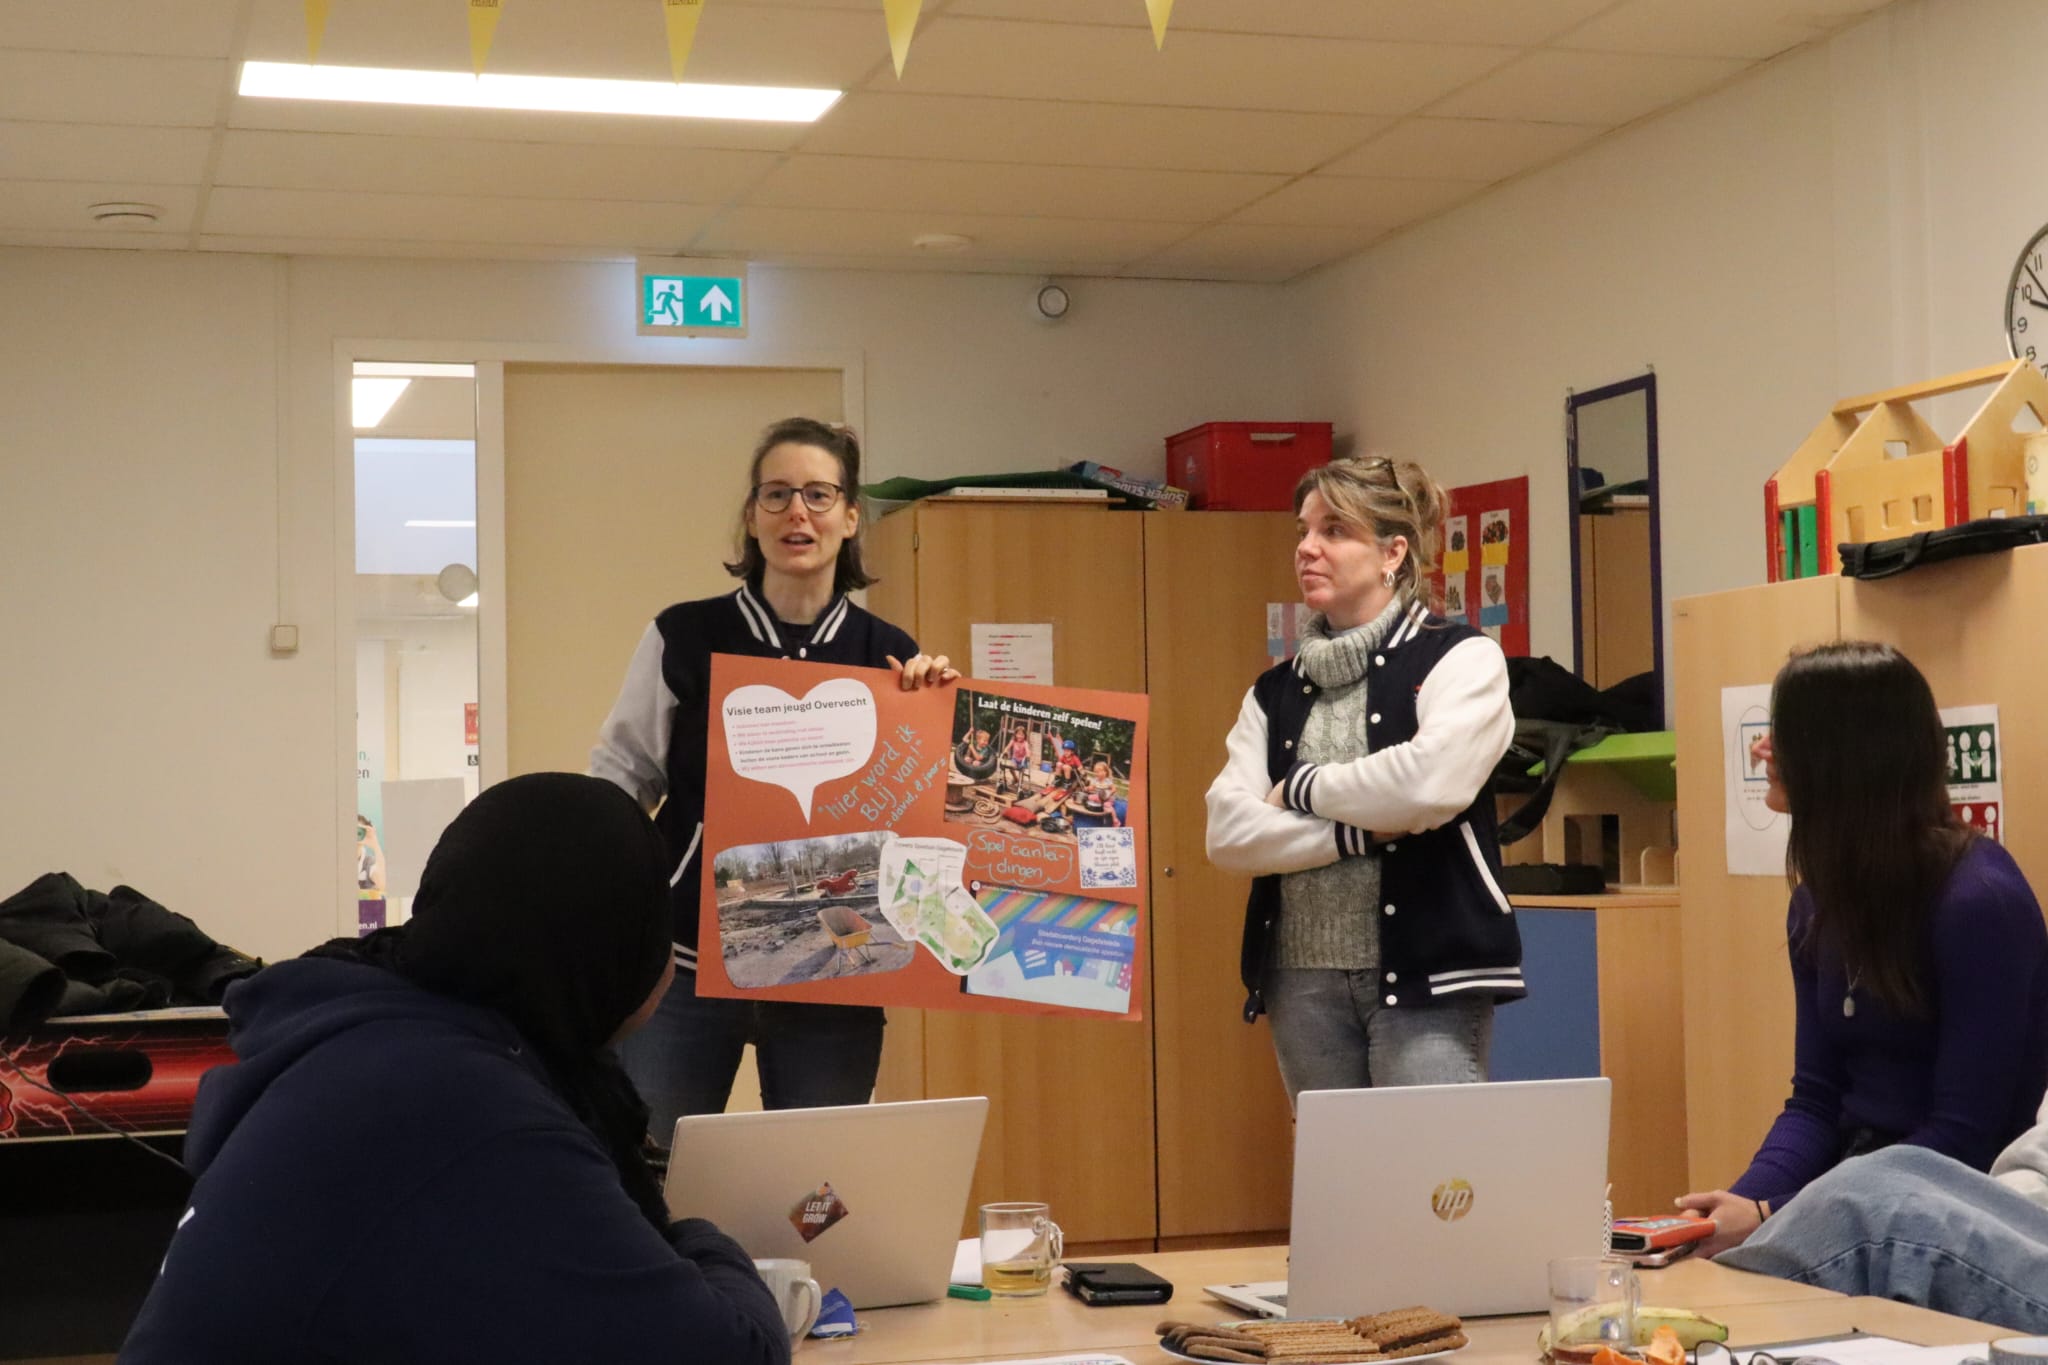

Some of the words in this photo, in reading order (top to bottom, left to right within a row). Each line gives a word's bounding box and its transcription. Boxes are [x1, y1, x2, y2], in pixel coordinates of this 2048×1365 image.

[2033, 253, 2043, 272] 11
[2021, 284, 2032, 301] 10
[2017, 316, 2028, 333] 9
[2025, 345, 2037, 361] 8
[1146, 487, 1185, 504] SUPER
[727, 706, 752, 716] Visie
[754, 704, 781, 714] team
[783, 702, 812, 714] jeugd
[814, 698, 867, 710] Overvecht
[978, 697, 998, 707] Laat
[1000, 701, 1011, 712] de
[1013, 702, 1051, 718] kinderen
[1052, 711, 1070, 723] zelf
[1070, 716, 1103, 730] spelen!
[861, 741, 900, 787] word
[896, 724, 917, 743] ik
[976, 834, 1005, 855] Spel
[805, 1201, 821, 1212] LET
[821, 1201, 831, 1212] IT
[1436, 1184, 1470, 1222] hp
[802, 1213, 827, 1224] GROW
